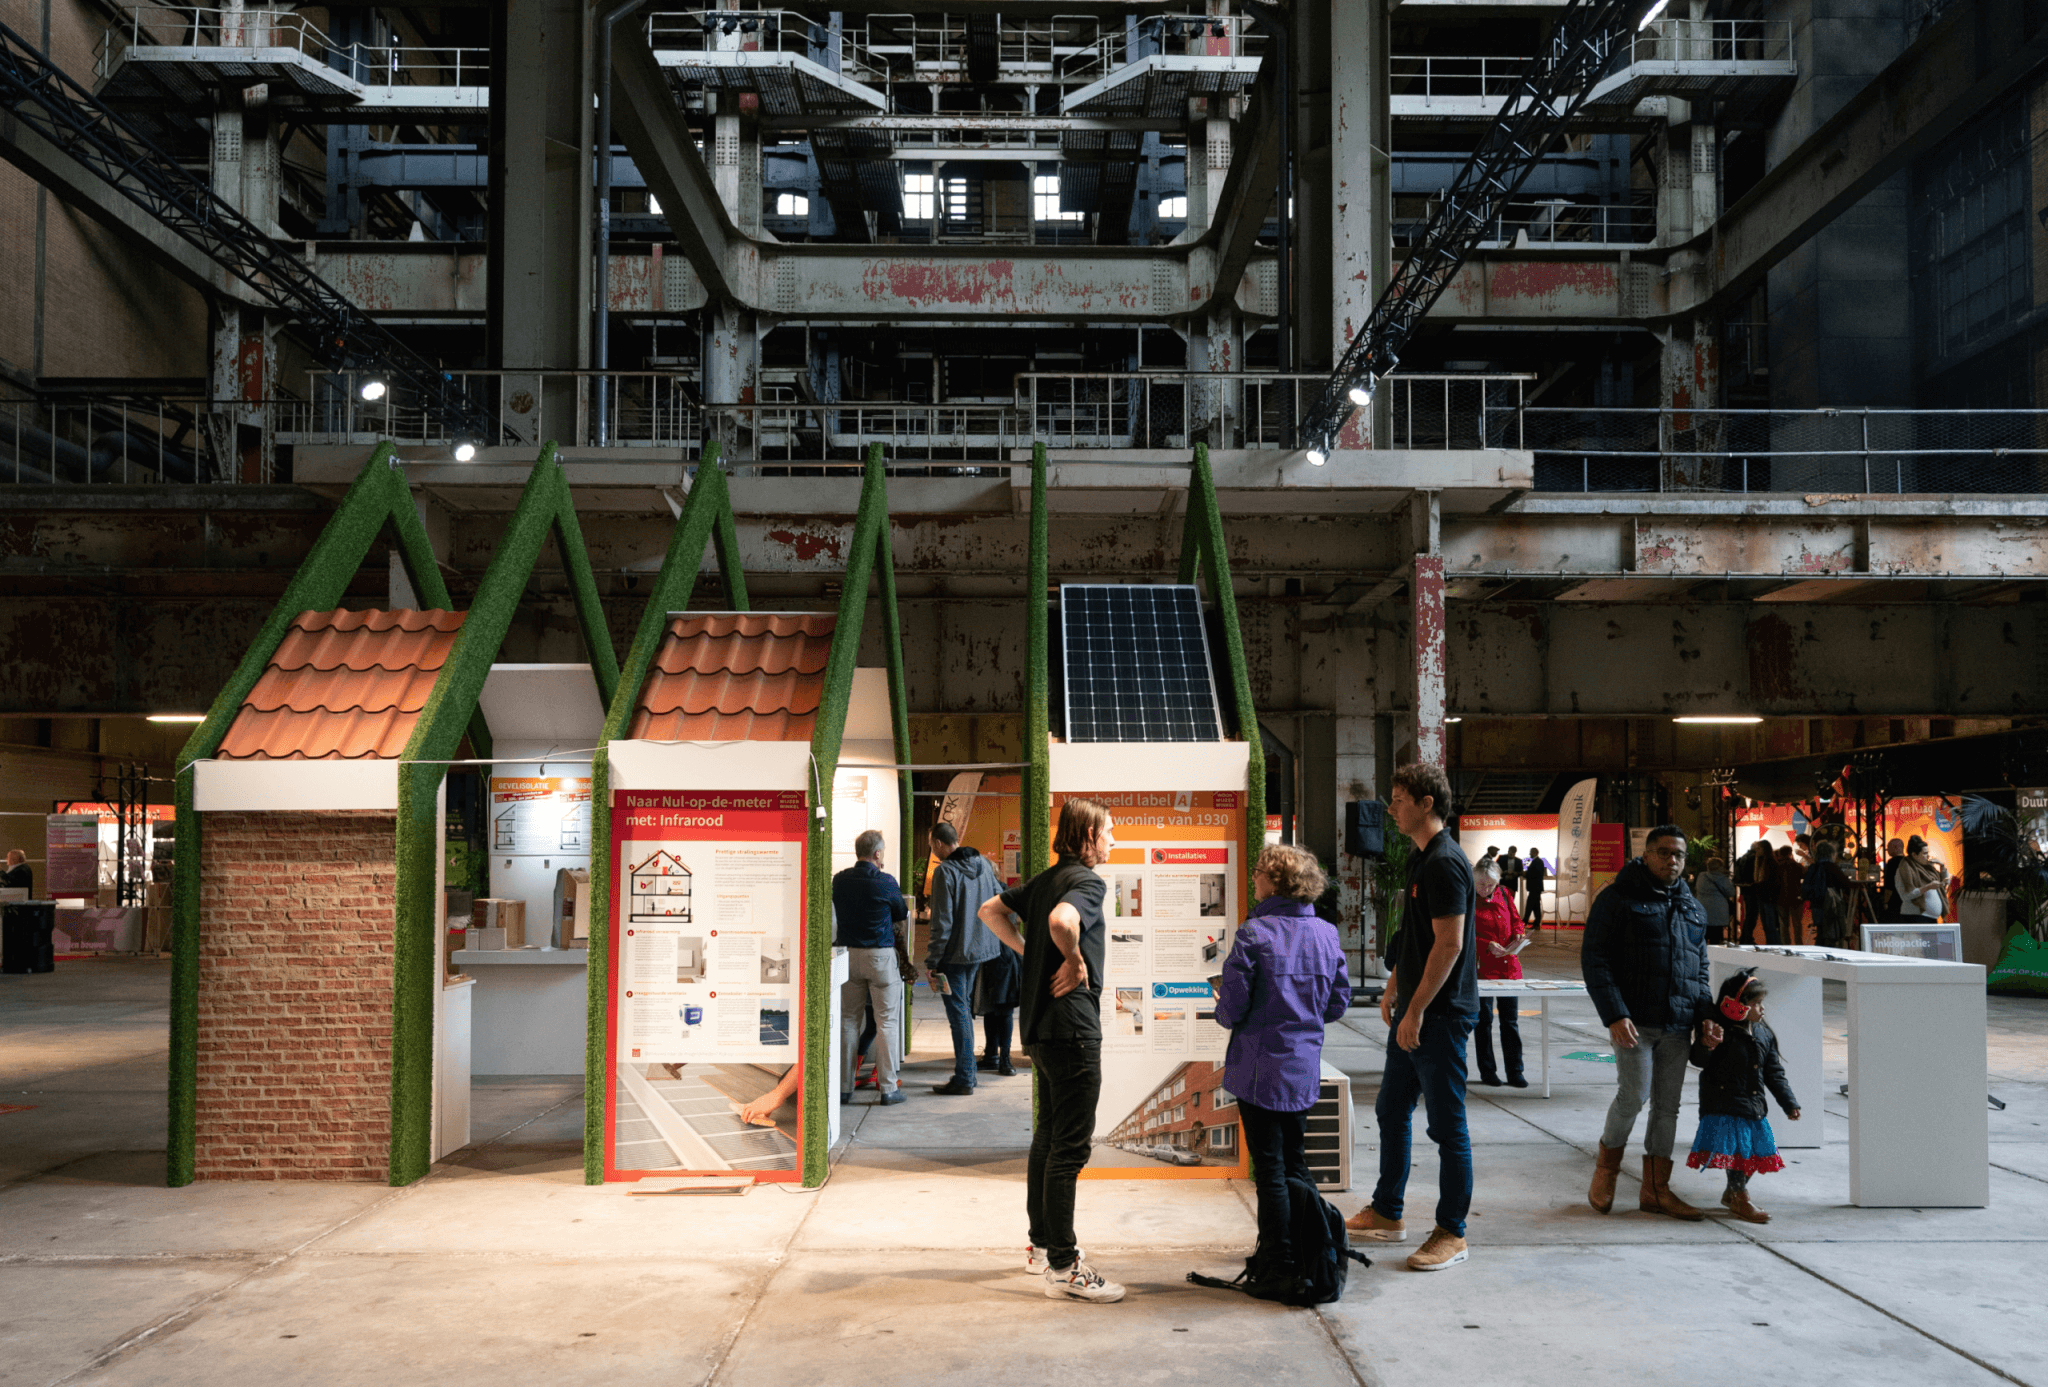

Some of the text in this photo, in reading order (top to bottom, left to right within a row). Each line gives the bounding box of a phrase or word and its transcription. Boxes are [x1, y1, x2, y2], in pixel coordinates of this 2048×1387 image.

[626, 795, 772, 810] Naar Nul-op-de-meter
[1063, 793, 1133, 806] Vbeeld
[1137, 793, 1171, 806] label
[1177, 793, 1190, 806] A
[943, 796, 959, 825] ORK
[1572, 794, 1584, 825] Bank
[626, 813, 723, 826] met: Infrarood
[1168, 816, 1193, 825] van
[1197, 814, 1229, 825] 1930
[1463, 817, 1506, 826] SNS bank
[1874, 939, 1931, 949] Inkoopactie:
[1168, 986, 1208, 995] Opwekking
